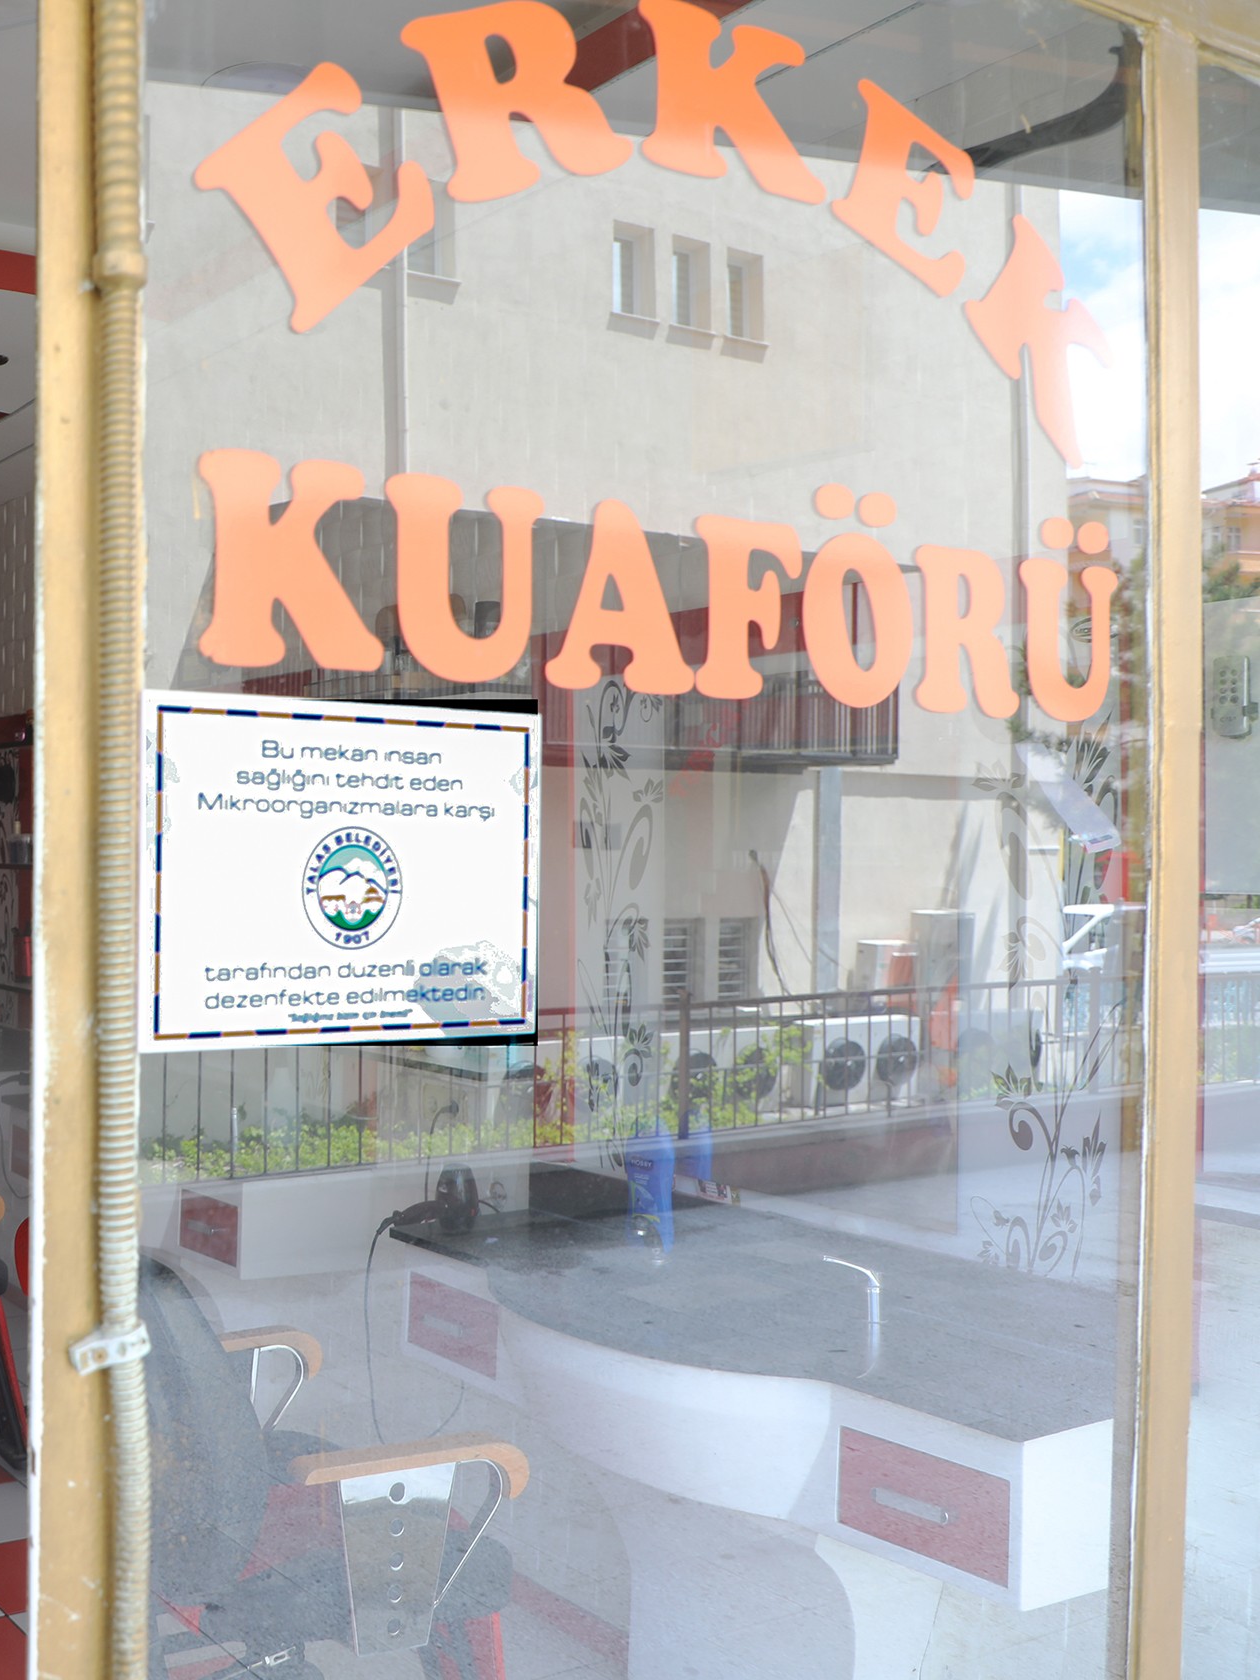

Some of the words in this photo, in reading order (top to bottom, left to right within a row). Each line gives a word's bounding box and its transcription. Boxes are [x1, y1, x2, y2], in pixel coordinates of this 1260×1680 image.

[198, 449, 1118, 722] KUAFÖRÜ
[261, 739, 295, 760] Bu
[300, 744, 378, 763] mekan
[409, 775, 463, 792] eden
[443, 801, 495, 822] karşı
[419, 957, 488, 977] olarak
[204, 988, 340, 1010] dezenfekte
